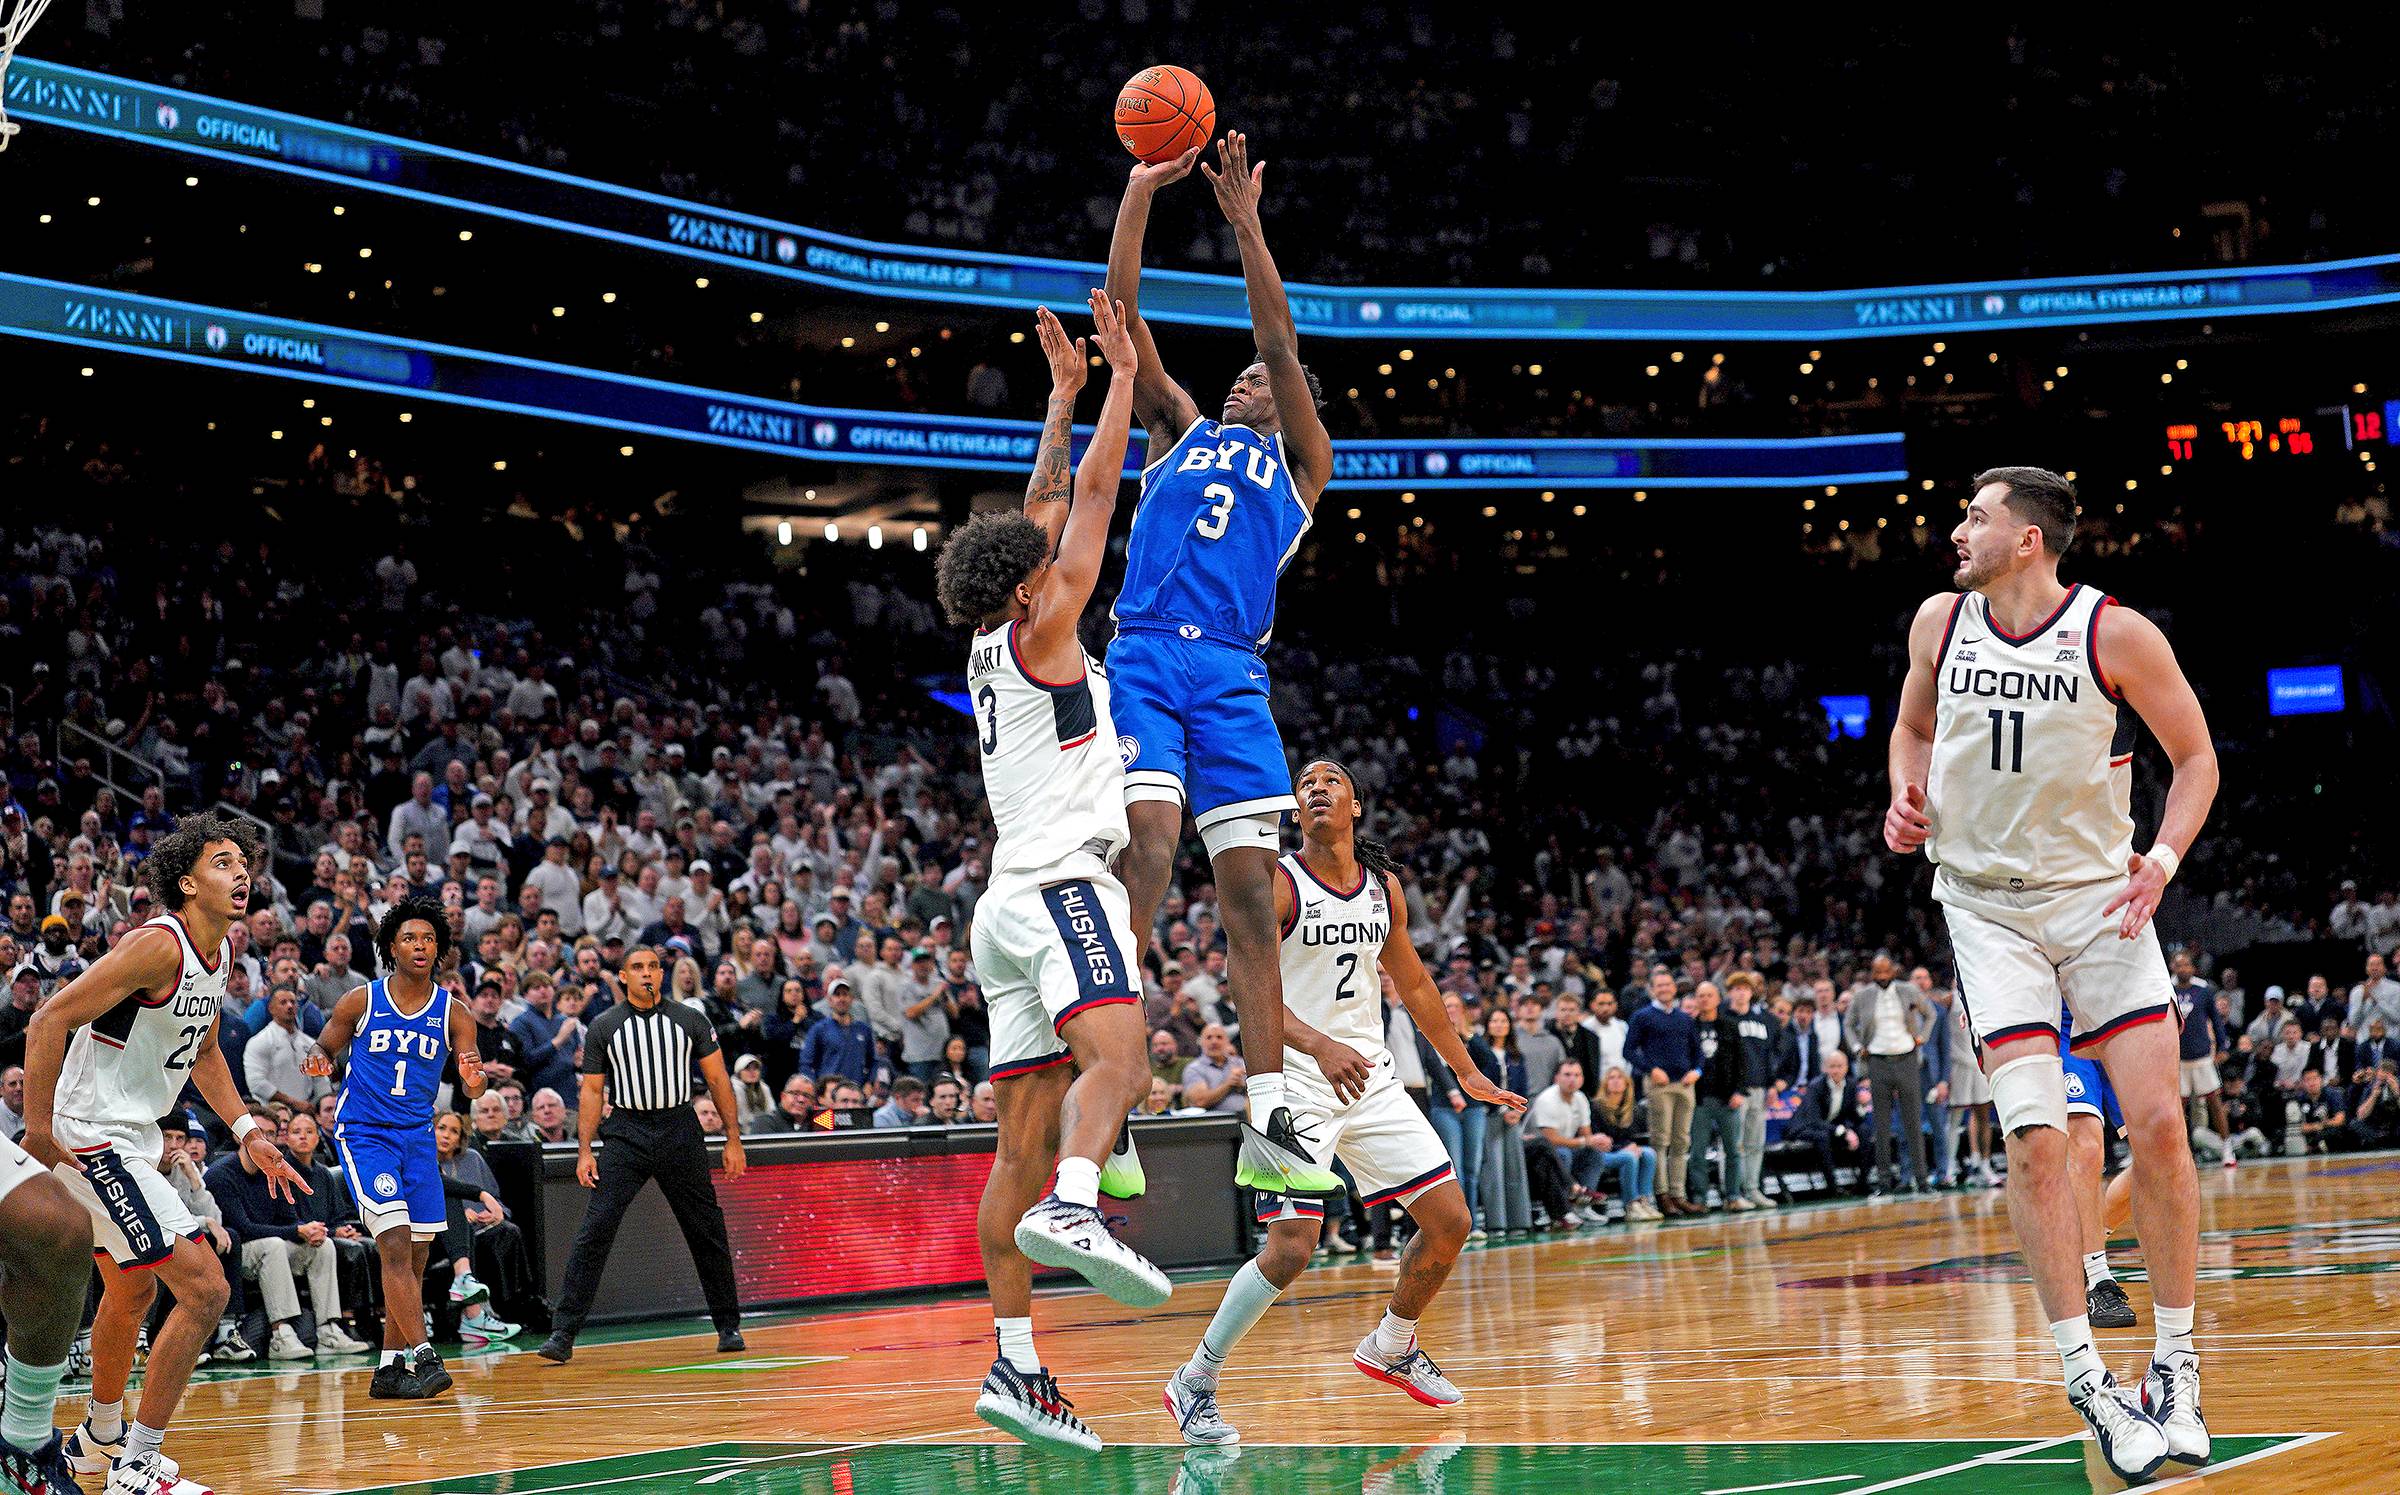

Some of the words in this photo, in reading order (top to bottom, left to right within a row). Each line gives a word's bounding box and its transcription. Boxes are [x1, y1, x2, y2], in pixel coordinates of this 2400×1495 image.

[7, 73, 123, 121] ZENNI
[196, 114, 281, 152] OFFICIAL
[805, 245, 868, 277] OFFICIAL
[869, 255, 950, 286] EYEWEAR
[952, 266, 977, 288] OF
[1395, 302, 1471, 324] OFFICIAL
[2018, 290, 2098, 313] OFFICIAL
[2099, 285, 2179, 308] EYEWEAR
[2181, 284, 2206, 304] OF
[64, 301, 174, 343] ZENNI
[243, 333, 324, 365] OFFICIAL
[850, 425, 927, 450] OFFICIAL
[928, 430, 1011, 455] EYEWEAR
[1013, 436, 1038, 458] OF
[1177, 439, 1279, 490] BYU
[1459, 453, 1535, 475] OFFICIAL
[1195, 482, 1236, 541] 3
[970, 643, 1003, 682] WART
[1950, 667, 2079, 703] UCONN
[978, 683, 998, 755] 3
[1988, 709, 2025, 773] 11
[1058, 886, 1115, 986] HUSKIES
[1302, 922, 1386, 946] UCONN
[1335, 952, 1358, 1001] 2
[368, 1028, 440, 1061] BYU
[390, 1060, 407, 1097] 1
[90, 1155, 152, 1253] HUSKIES
